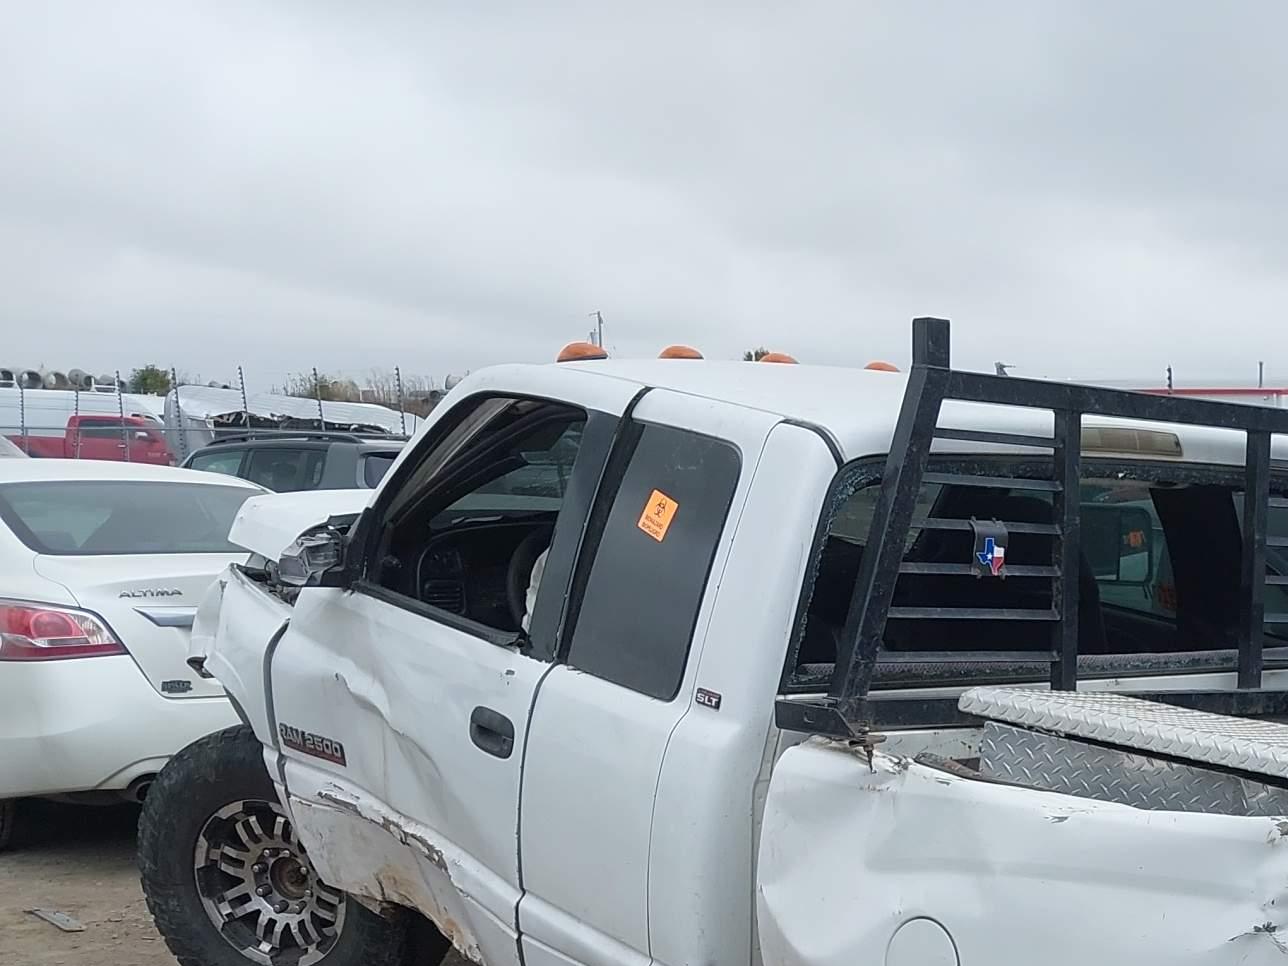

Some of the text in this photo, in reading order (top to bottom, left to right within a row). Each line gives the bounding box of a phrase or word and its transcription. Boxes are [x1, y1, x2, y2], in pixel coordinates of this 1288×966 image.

[118, 588, 184, 599] ALTIMA
[696, 692, 719, 707] SLT
[279, 725, 342, 758] RAM 2500
